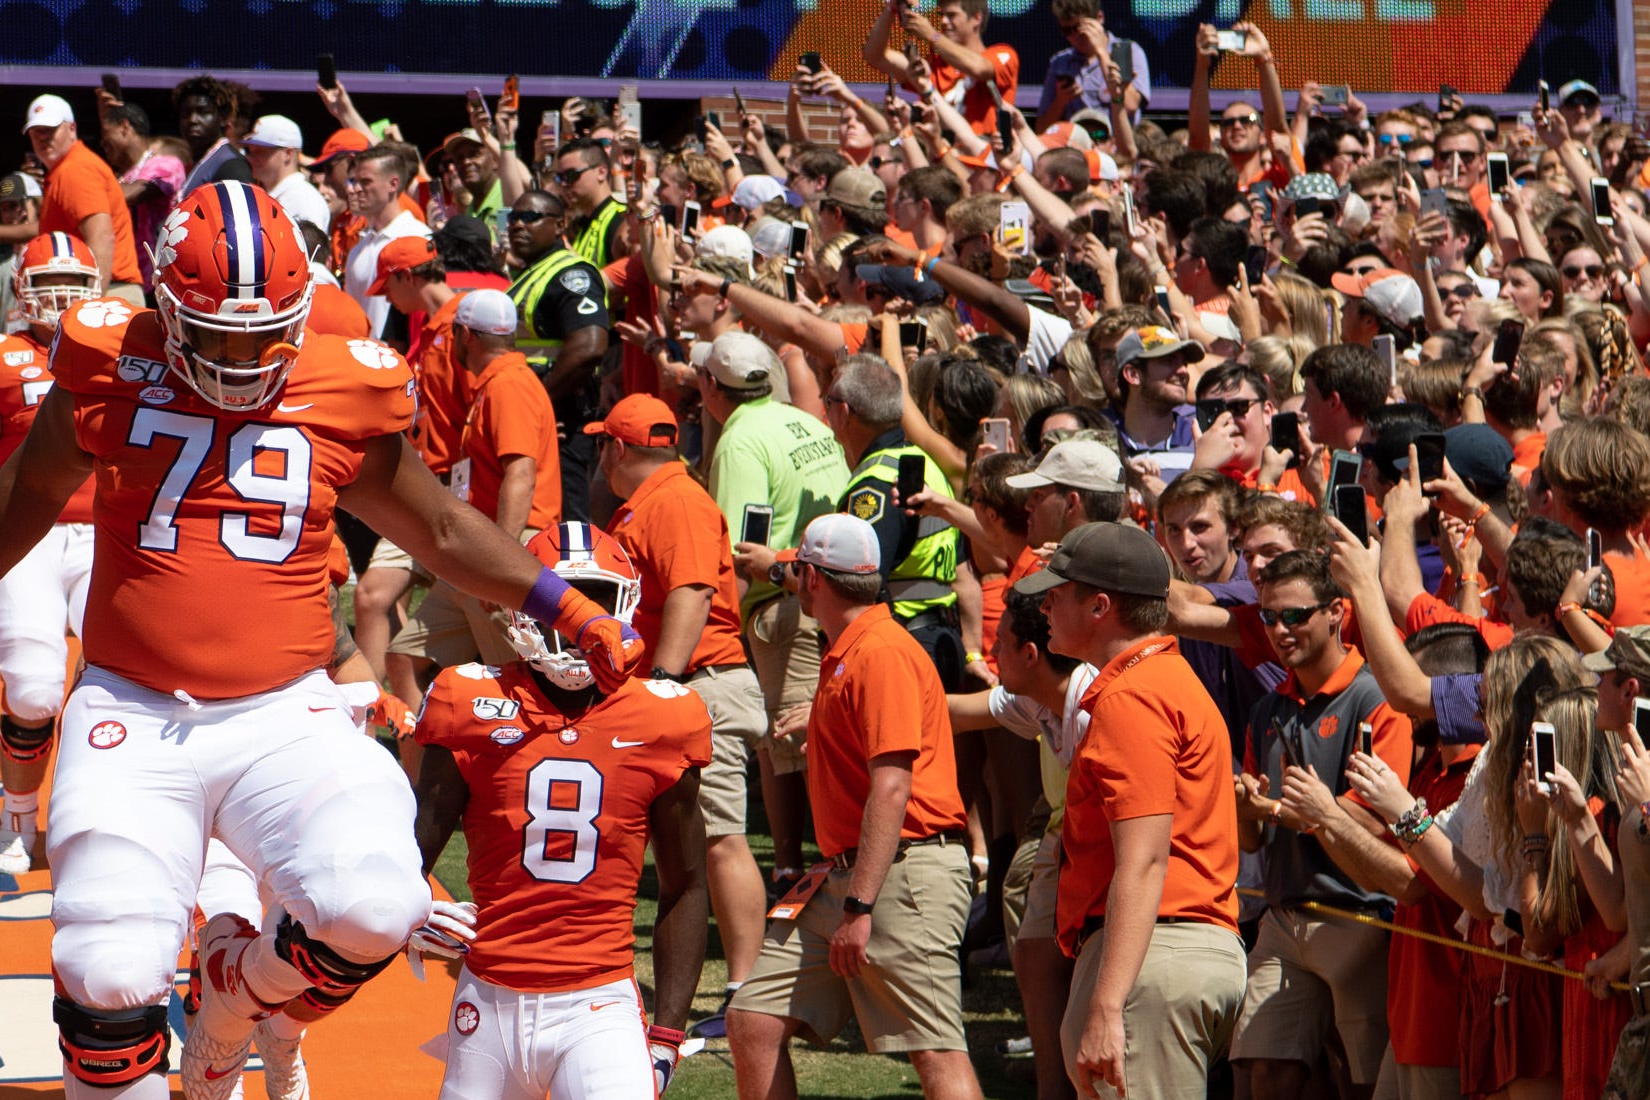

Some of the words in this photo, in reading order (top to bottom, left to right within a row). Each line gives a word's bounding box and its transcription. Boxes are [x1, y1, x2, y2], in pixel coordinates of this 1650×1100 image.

[118, 354, 169, 385] 150
[147, 385, 174, 399] ACC
[125, 405, 313, 566] 79
[566, 669, 579, 677] ALL
[472, 697, 520, 720] 150
[496, 729, 520, 739] ACC
[520, 757, 604, 886] 8
